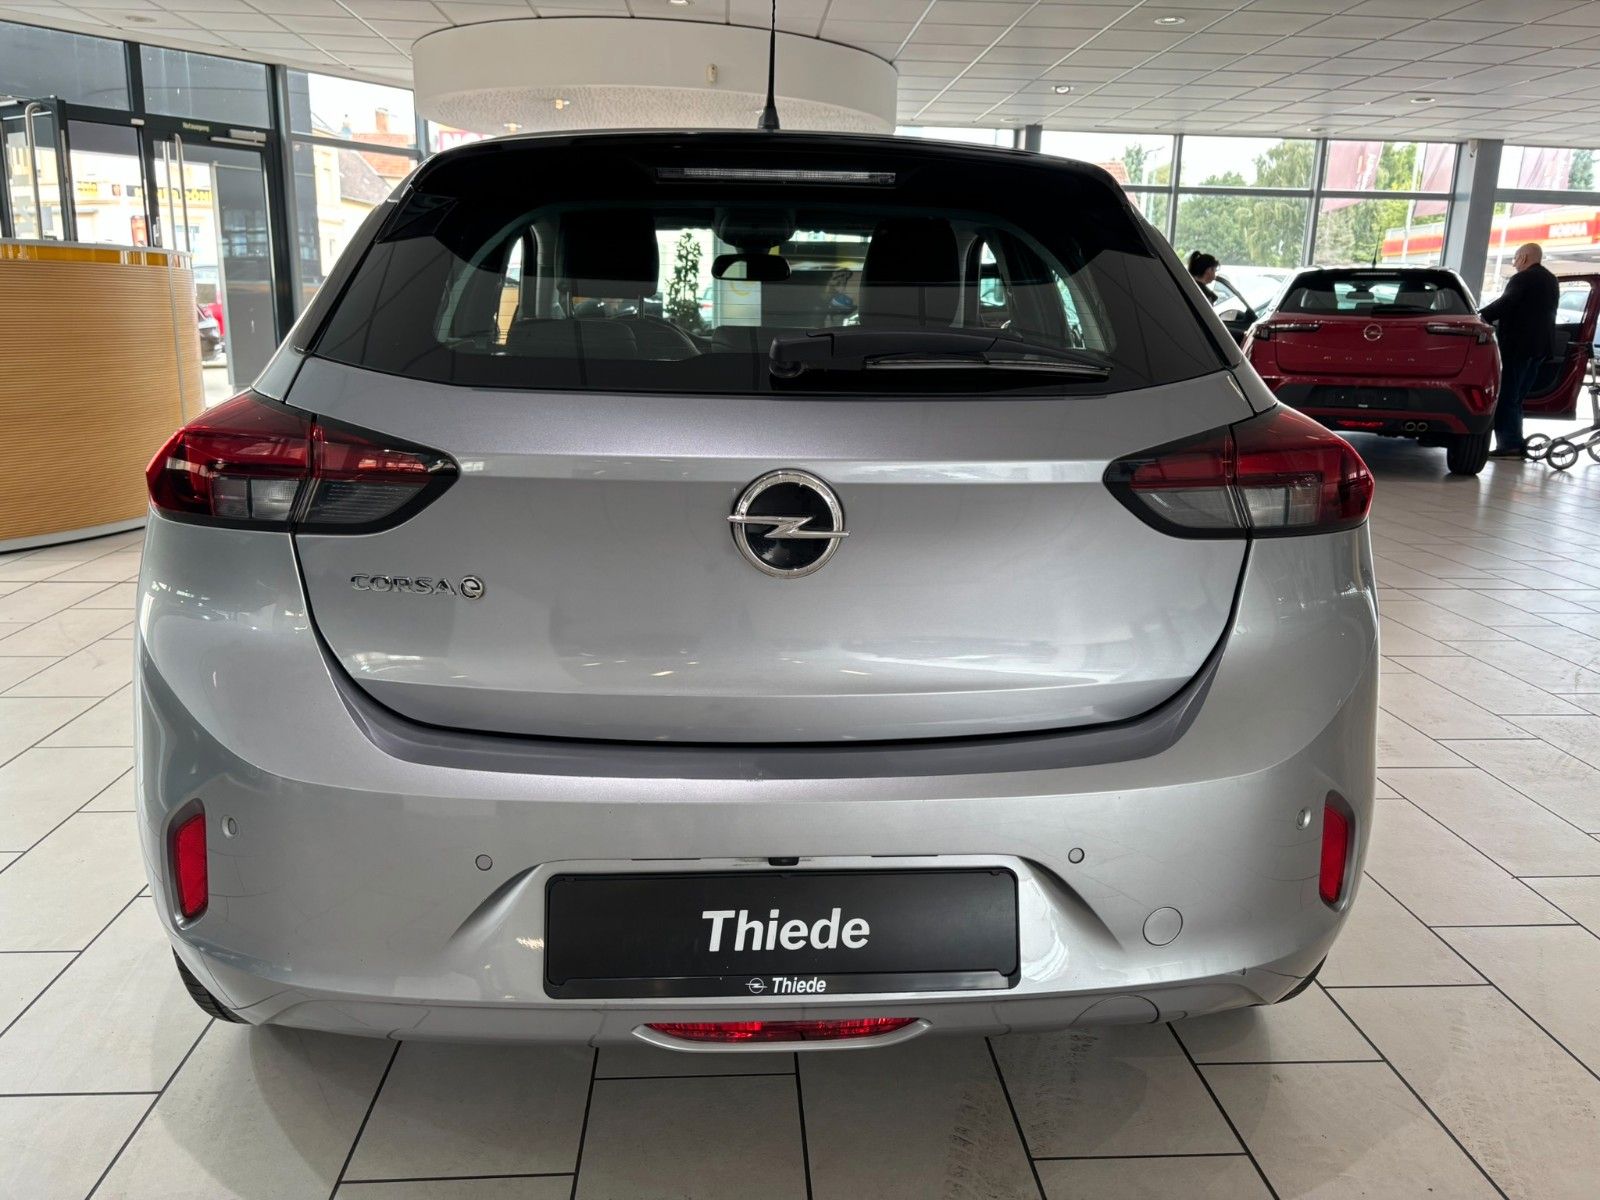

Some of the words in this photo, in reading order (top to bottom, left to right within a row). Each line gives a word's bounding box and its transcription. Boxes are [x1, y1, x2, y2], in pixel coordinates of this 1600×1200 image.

[351, 573, 457, 596] CORSA
[702, 907, 870, 952] Thiede
[772, 976, 827, 994] Thiede
